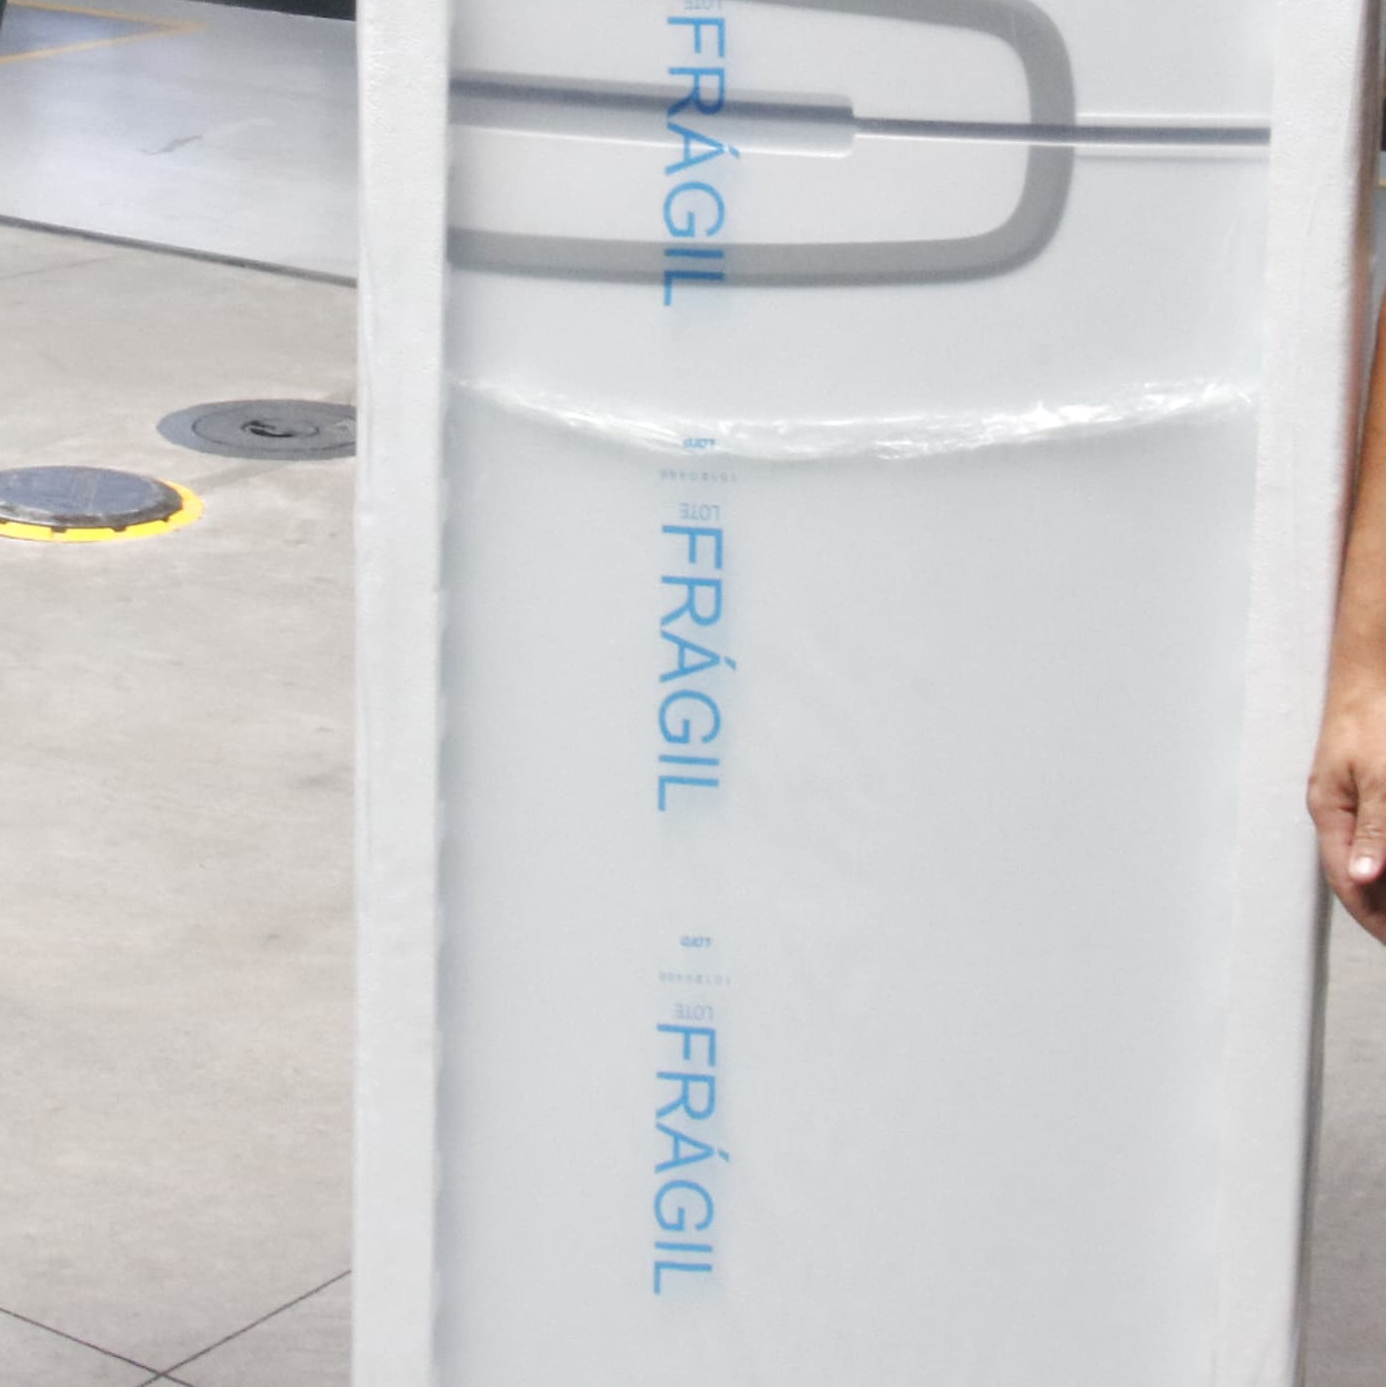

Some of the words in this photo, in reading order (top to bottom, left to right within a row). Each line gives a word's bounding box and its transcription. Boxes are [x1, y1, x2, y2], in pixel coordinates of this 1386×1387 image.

[663, 16, 741, 307] FRÁGIL
[657, 525, 737, 812] FRÁGIL
[653, 1023, 731, 1295] FRÁGIL
